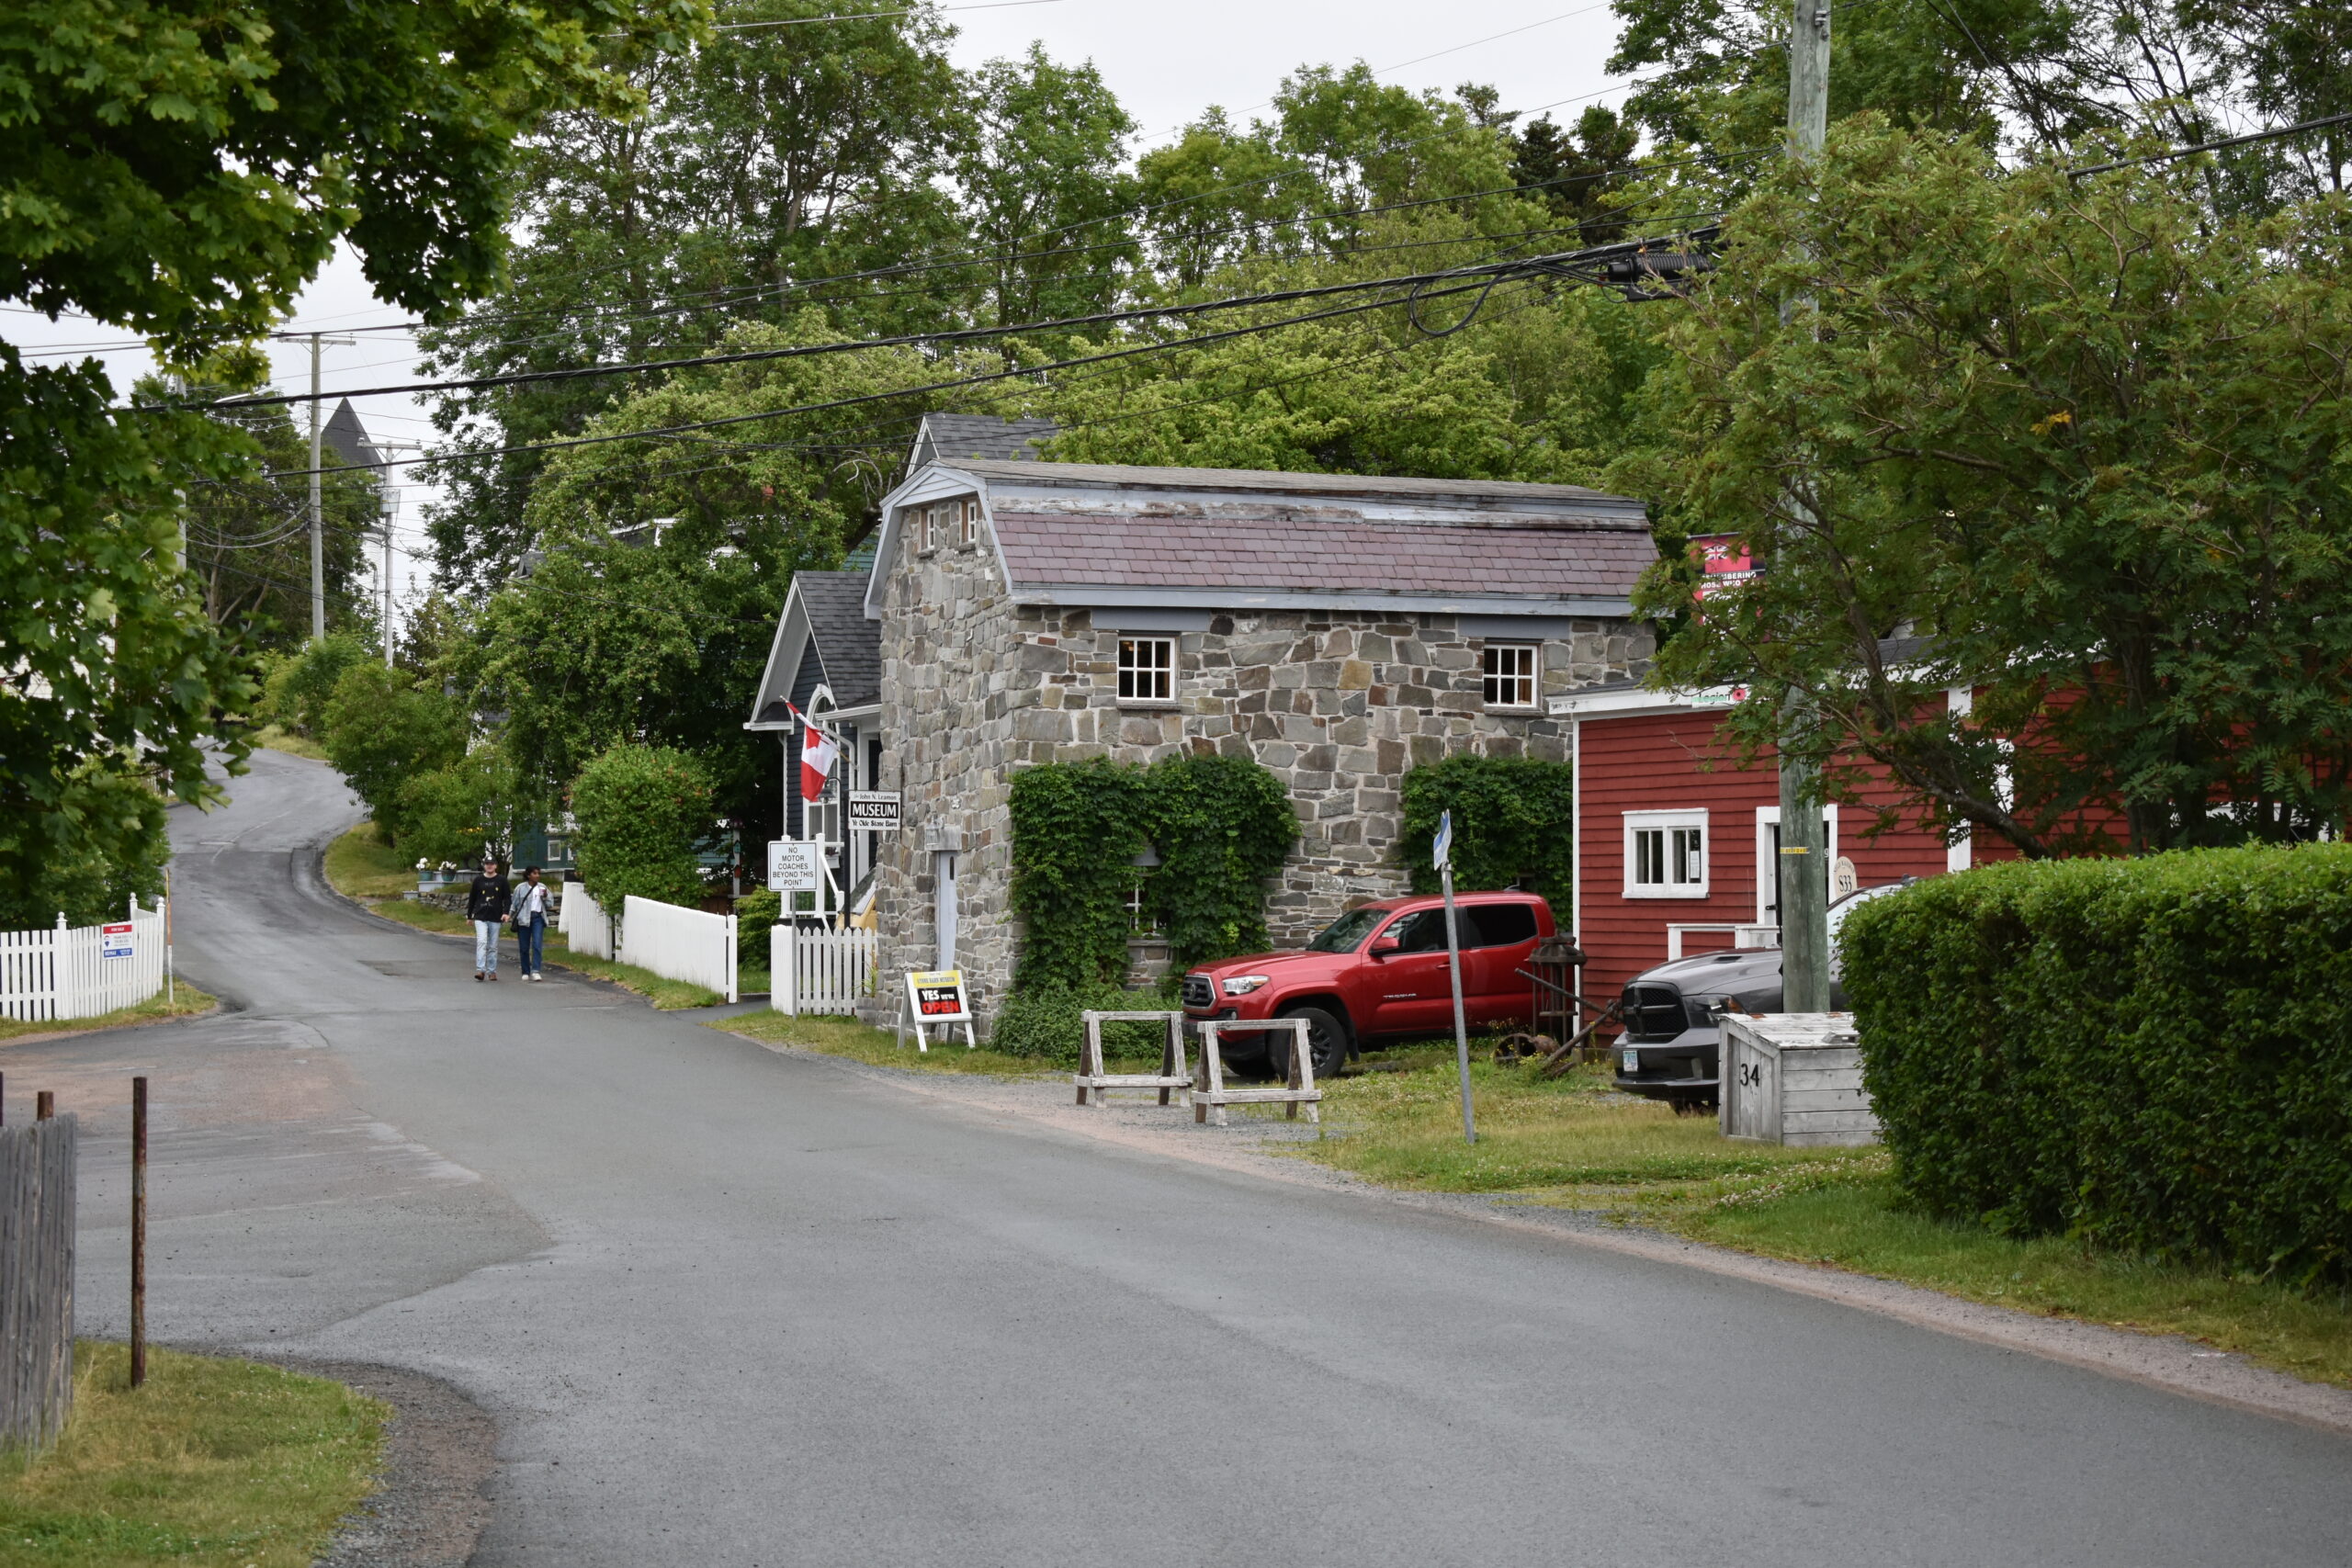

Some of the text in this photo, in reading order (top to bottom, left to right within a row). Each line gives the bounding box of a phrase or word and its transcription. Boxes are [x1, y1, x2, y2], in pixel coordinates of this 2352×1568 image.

[1699, 692, 1731, 705] Legion
[853, 803, 897, 818] MUSEUM
[922, 990, 940, 1001] YES
[922, 1000, 960, 1015] OPEN
[1740, 1064, 1759, 1087] 34
